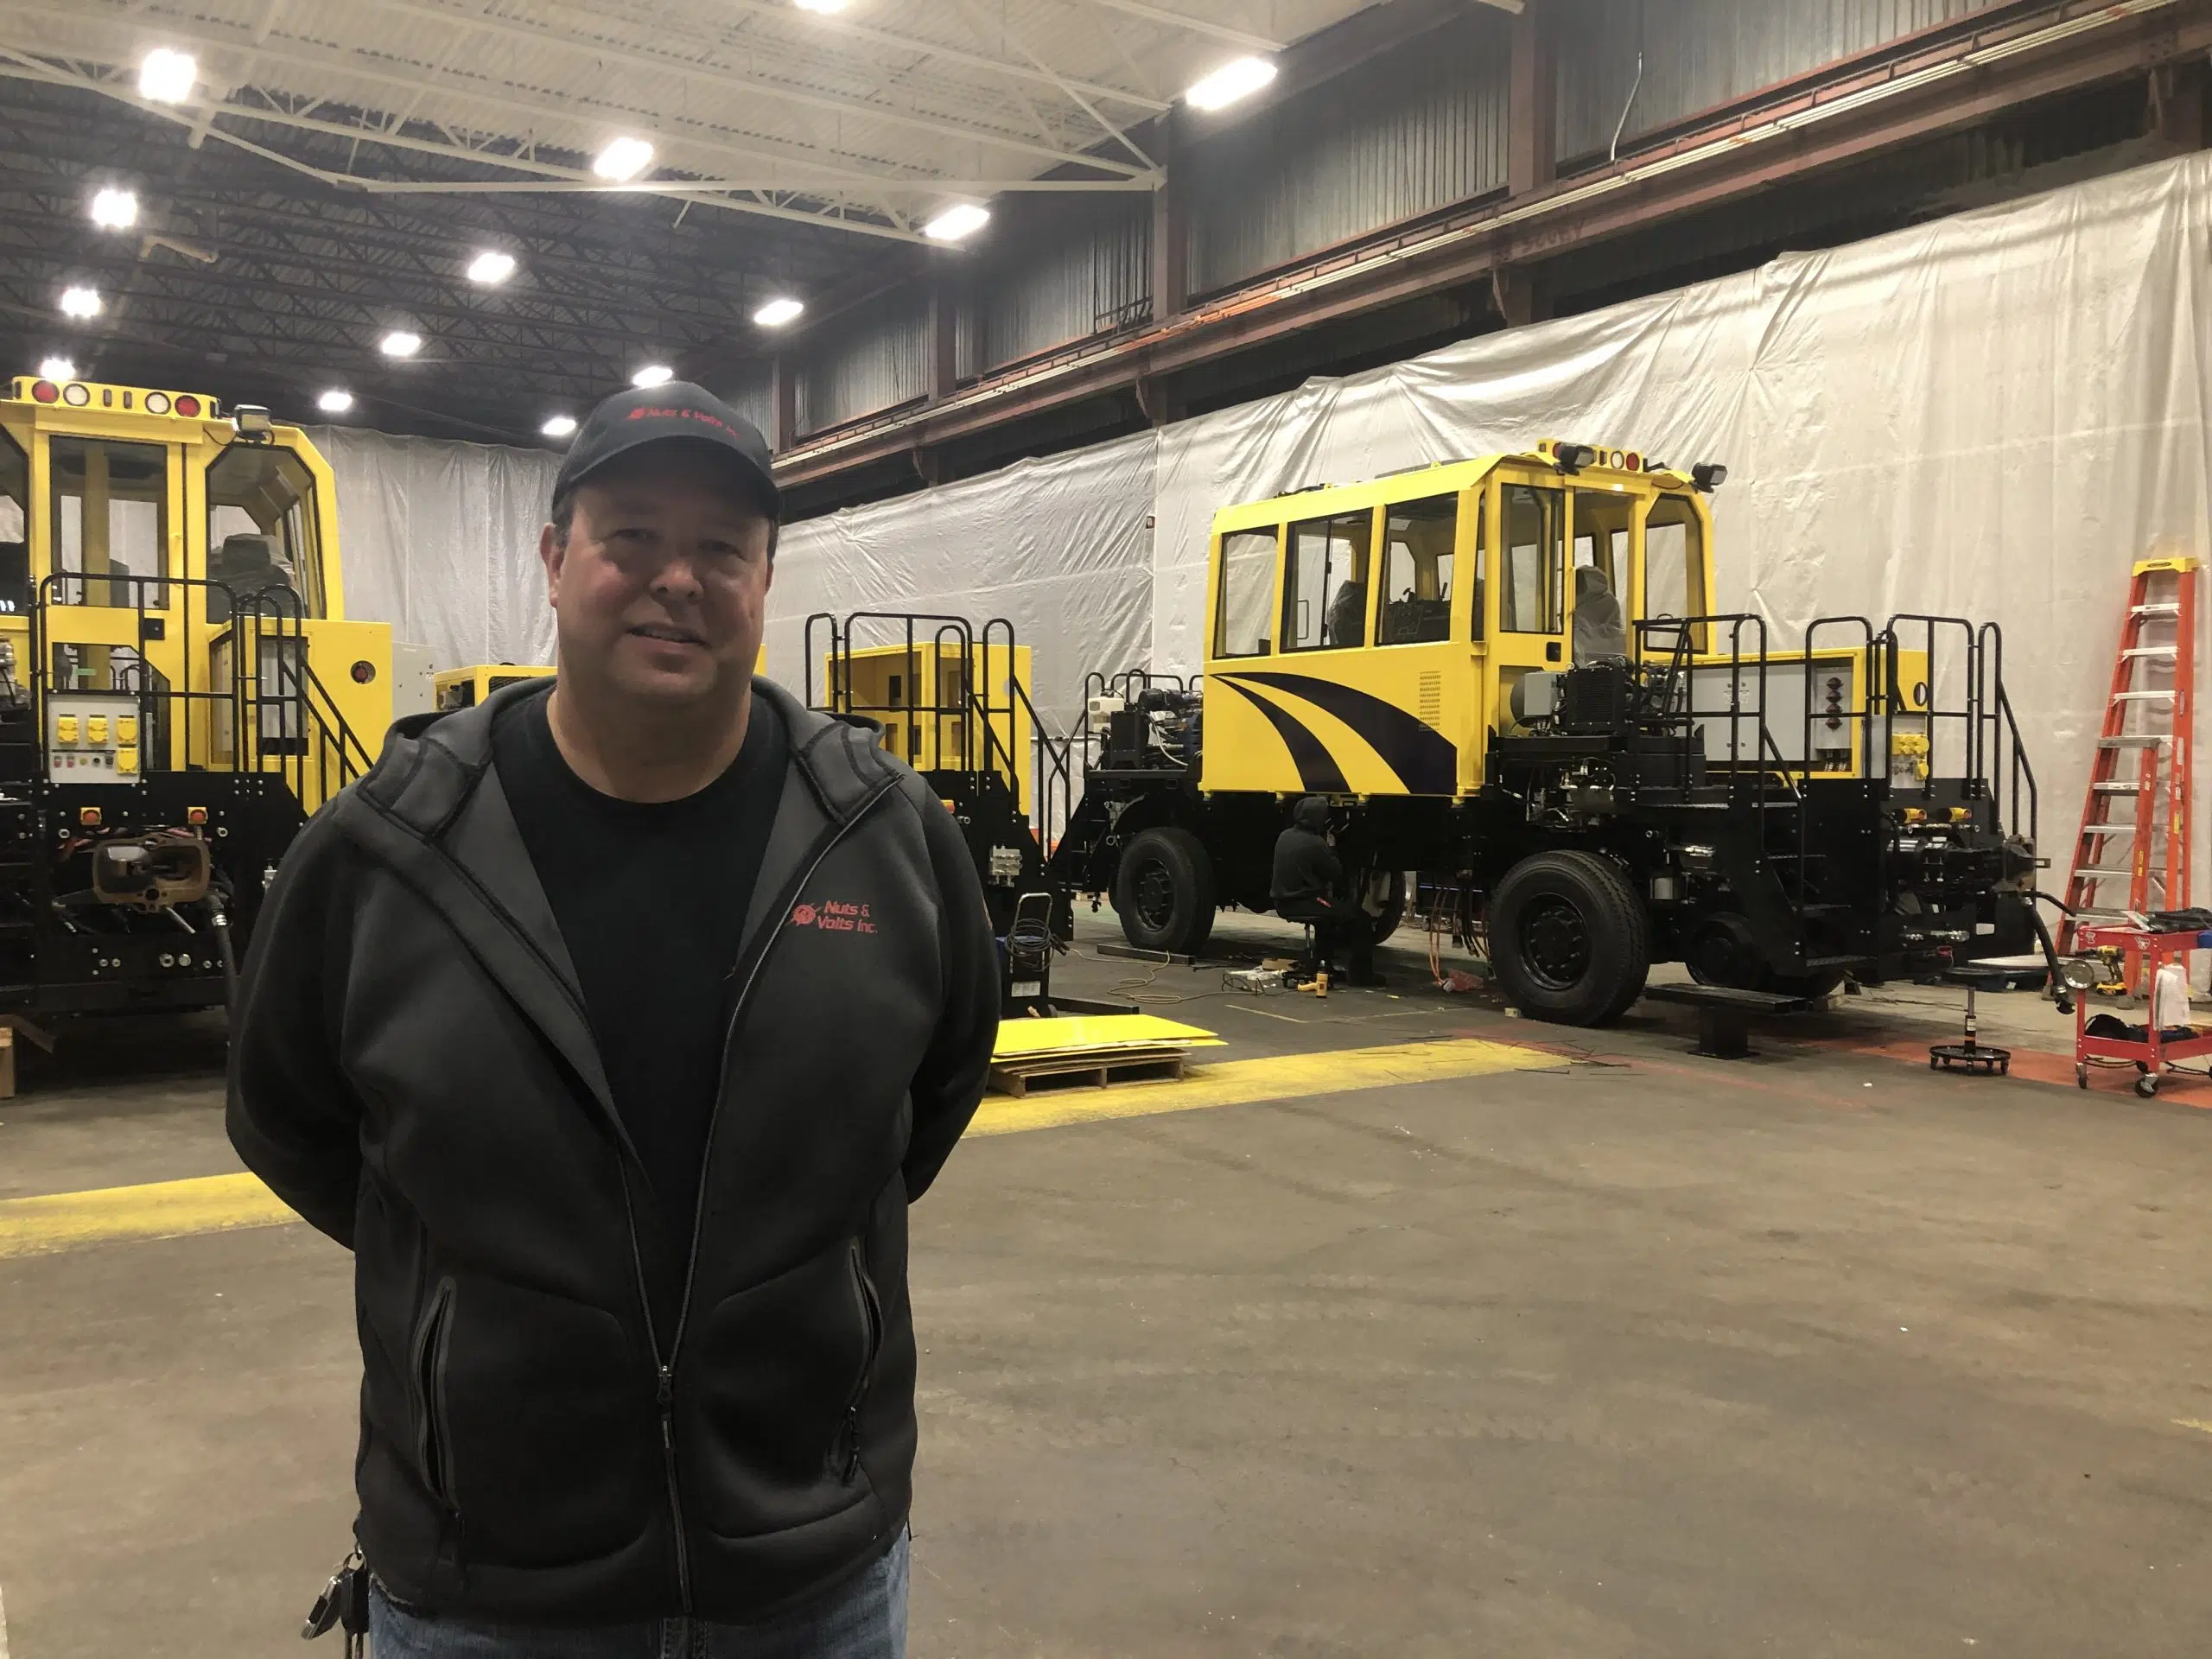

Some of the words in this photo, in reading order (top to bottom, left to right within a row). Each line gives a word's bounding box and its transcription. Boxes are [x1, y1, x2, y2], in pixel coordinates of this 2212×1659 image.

[824, 900, 858, 915] Nuts
[861, 905, 870, 917] &
[817, 916, 854, 929] Volts
[857, 919, 878, 933] Inc.
